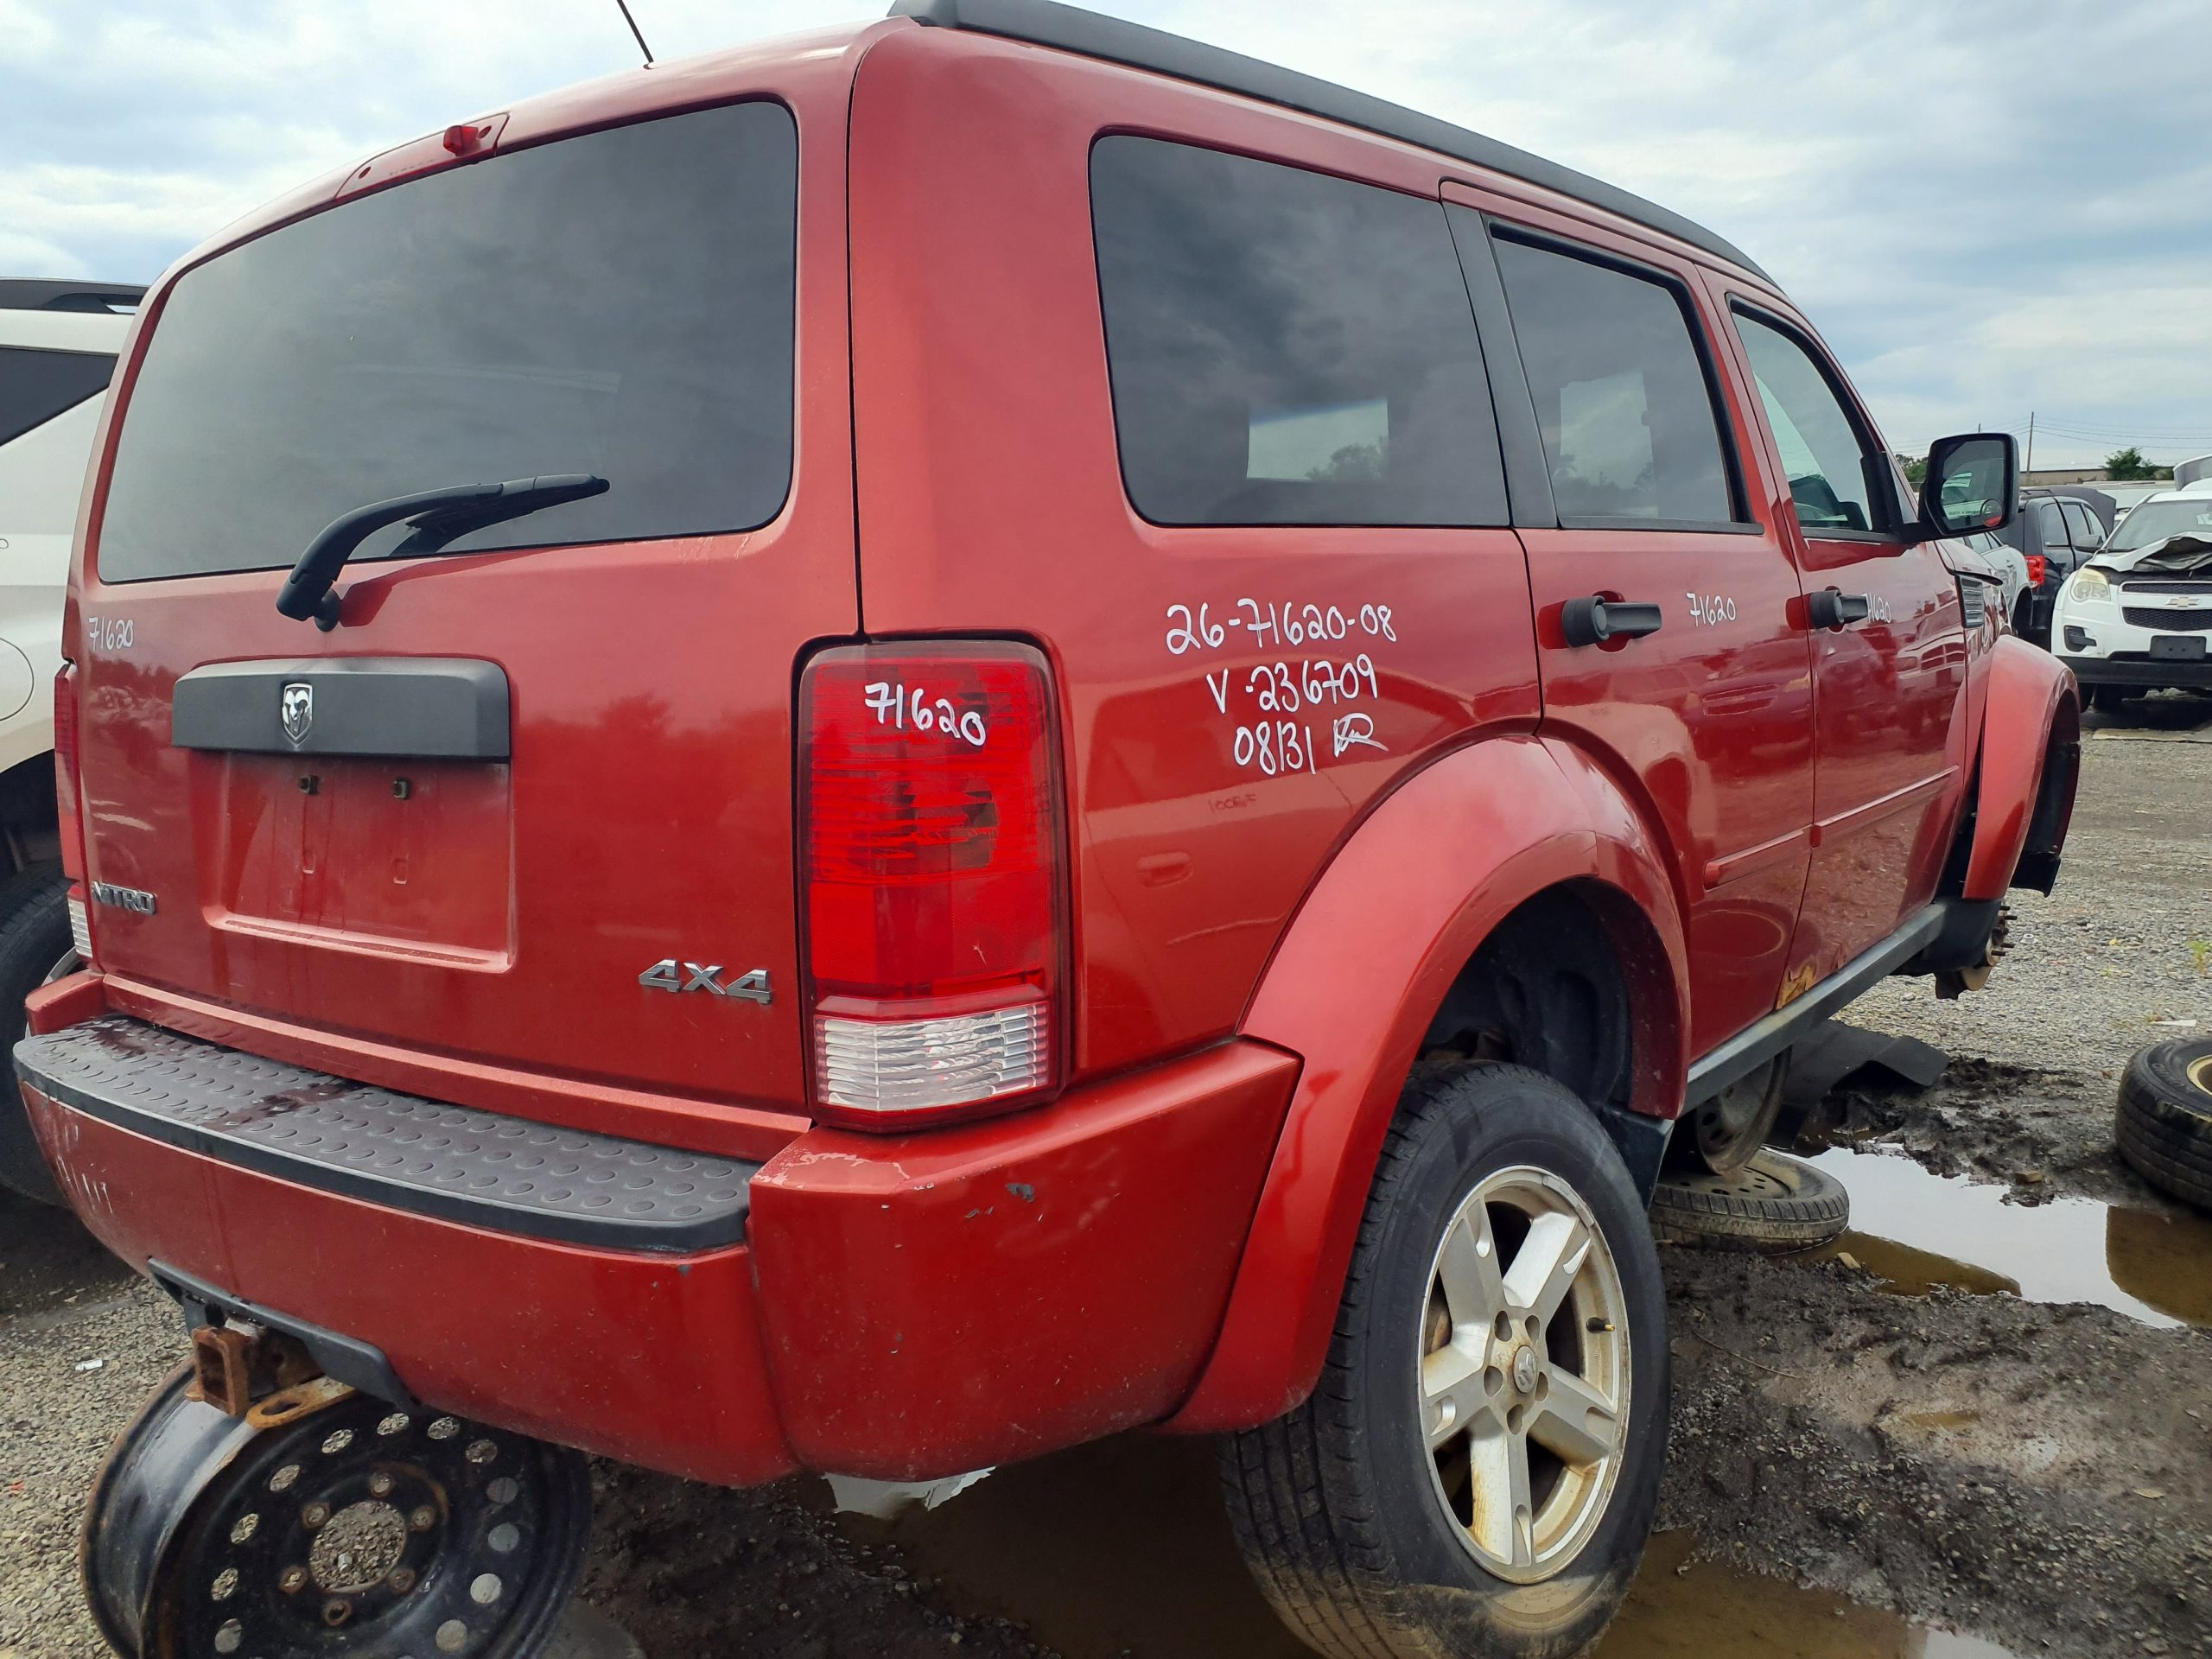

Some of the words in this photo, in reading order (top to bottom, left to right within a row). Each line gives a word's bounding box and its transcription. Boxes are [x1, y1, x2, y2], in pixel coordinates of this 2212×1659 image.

[1166, 598, 1397, 654] 26-71620-08
[1686, 592, 1737, 626] 71620
[88, 616, 134, 651] 71620
[864, 682, 987, 747] 71620
[91, 880, 157, 915] NITRO
[639, 958, 772, 1004] 4X4
